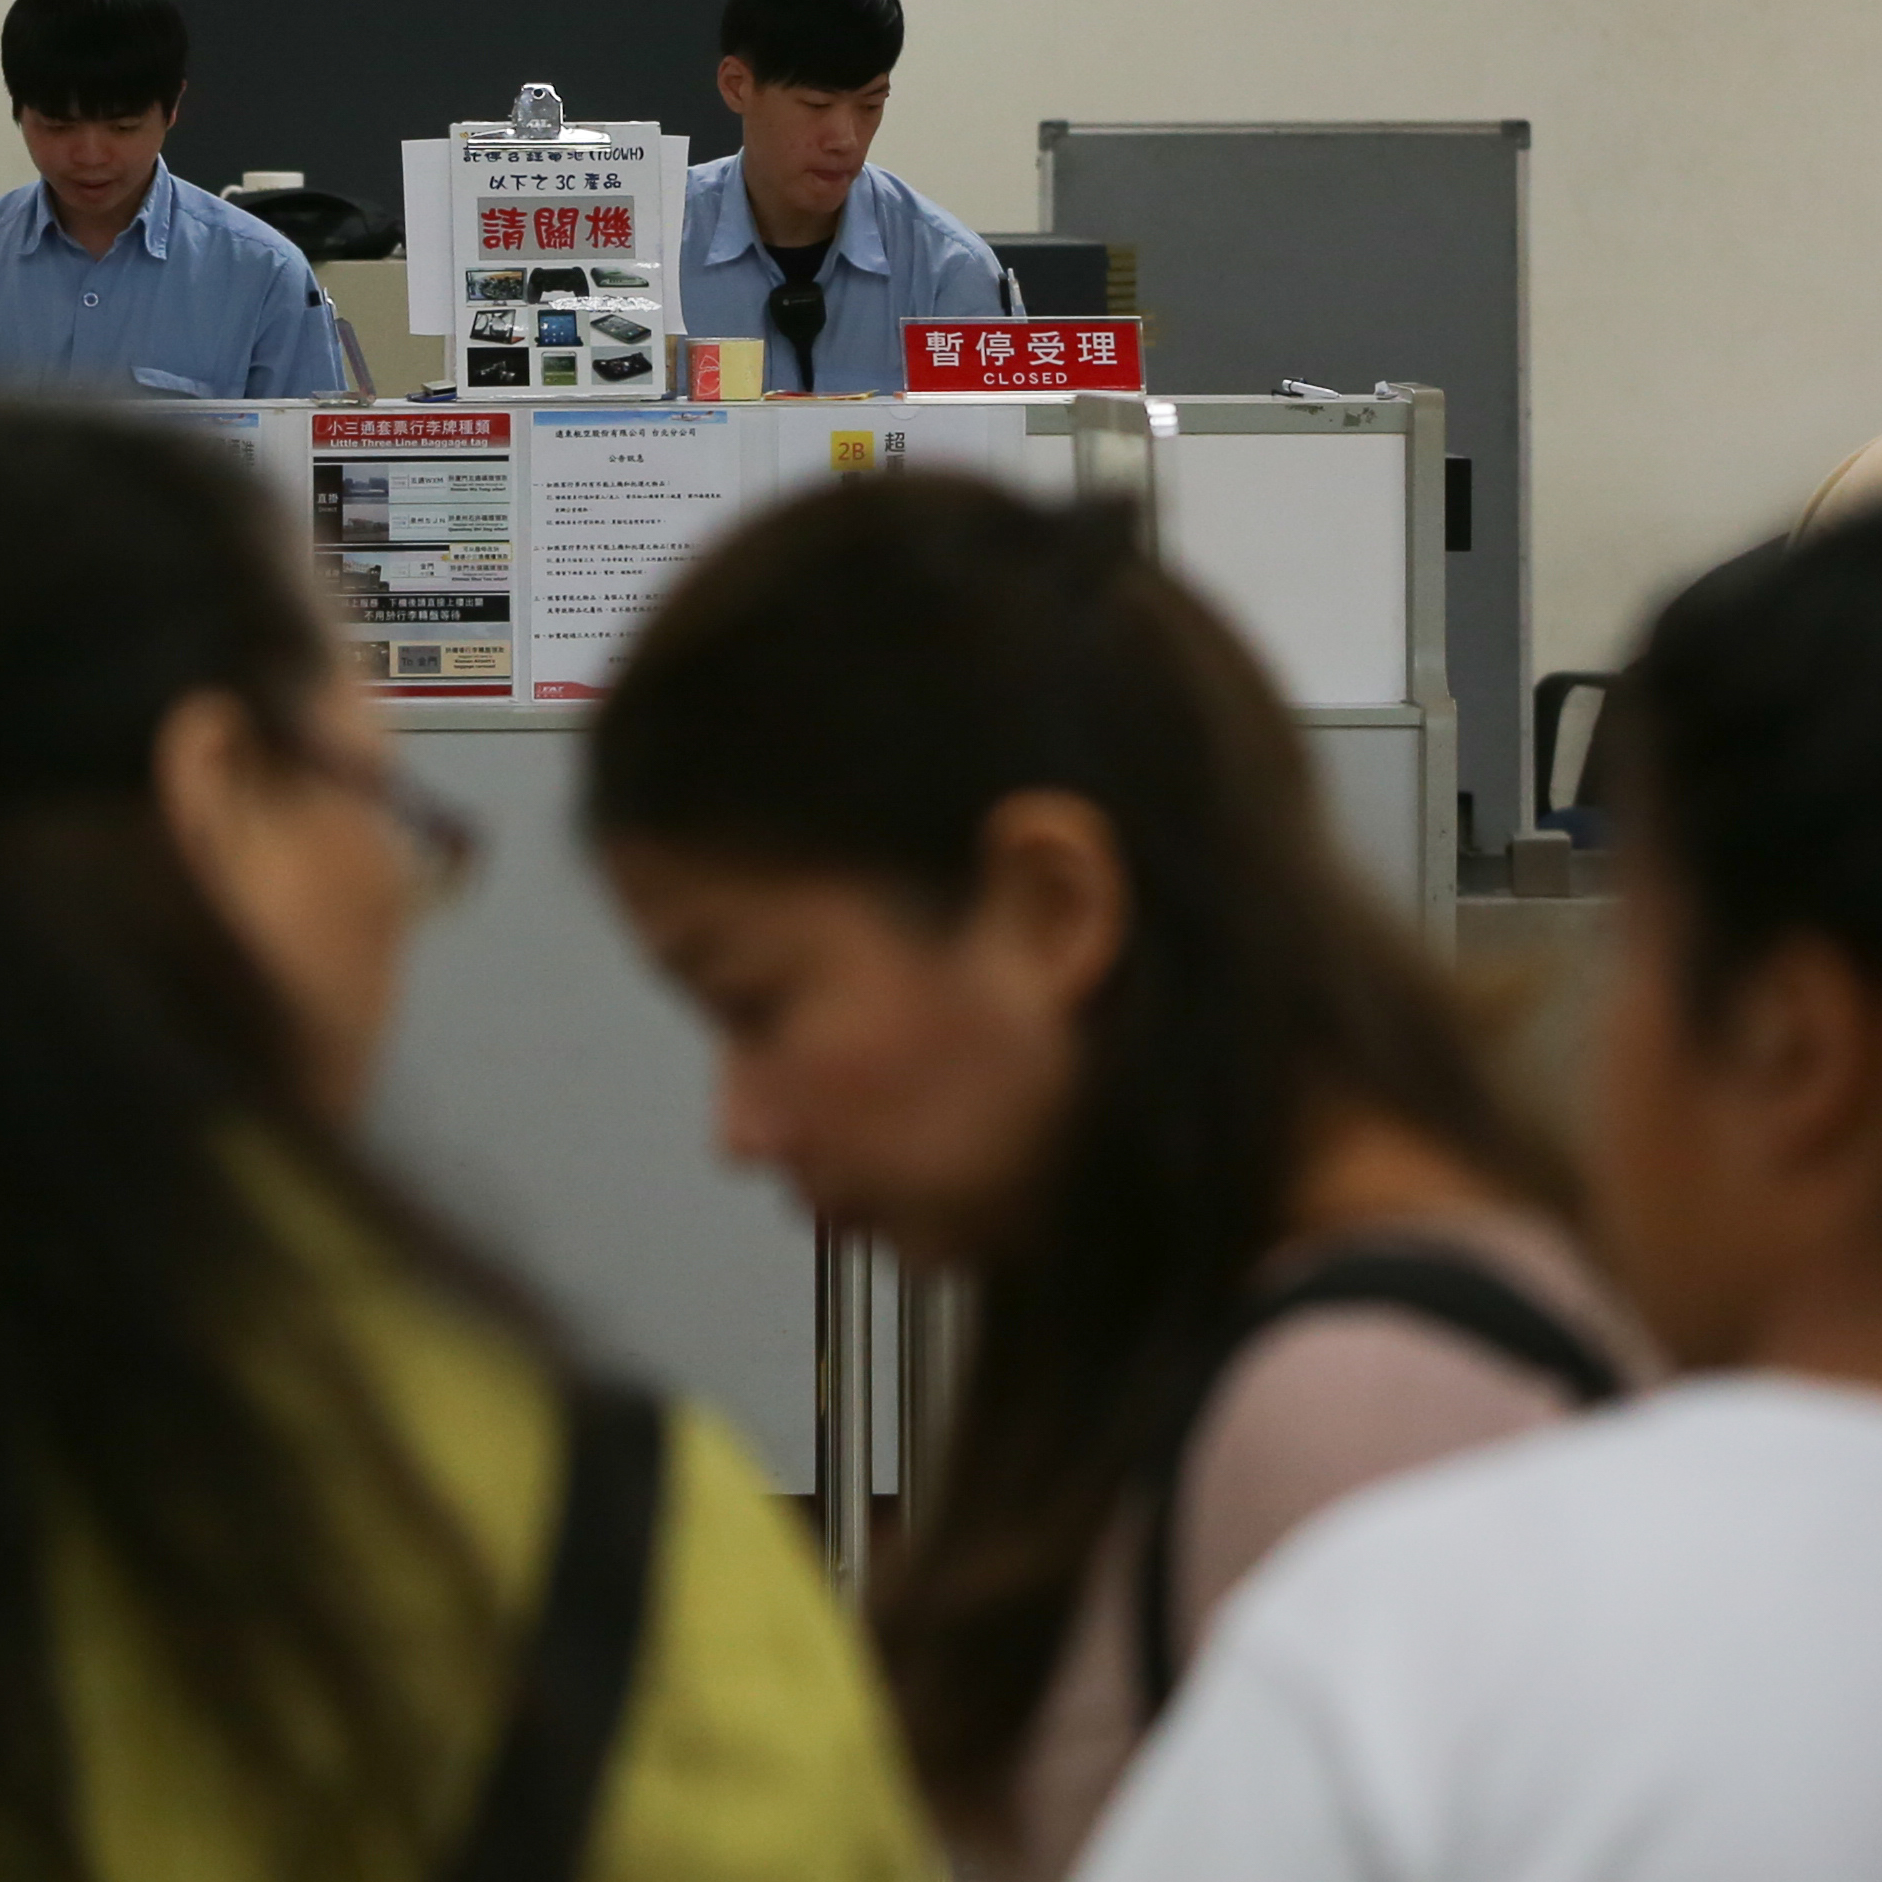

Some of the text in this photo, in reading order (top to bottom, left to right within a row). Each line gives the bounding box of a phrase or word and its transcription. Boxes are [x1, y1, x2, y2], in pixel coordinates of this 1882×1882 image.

[481, 205, 633, 251] 請關機
[925, 330, 1118, 367] 暫停受理
[983, 372, 1068, 385] CLOSED
[328, 419, 490, 436] 小三通套票行李牌種類
[330, 438, 488, 449] Little Three Line Baggage tag
[838, 440, 865, 461] 2B
